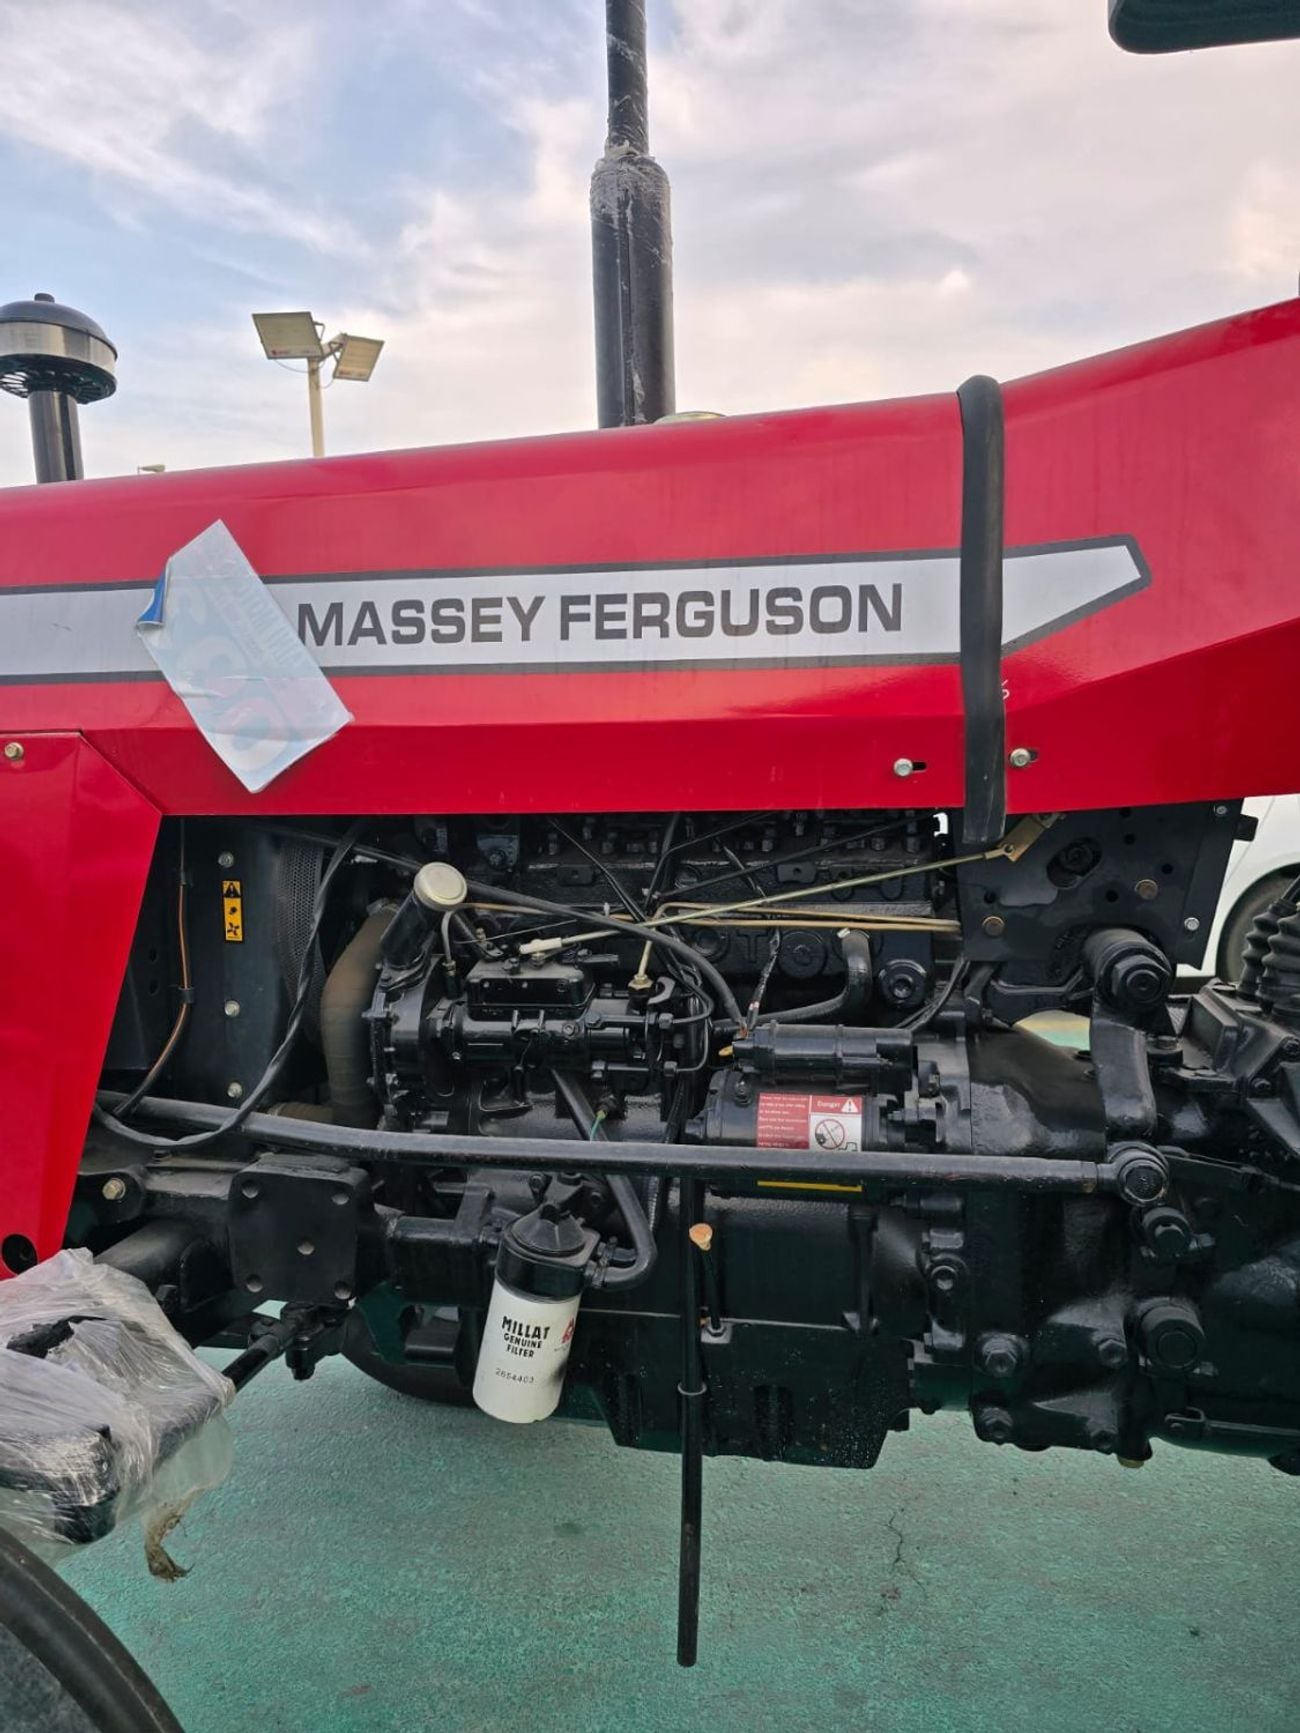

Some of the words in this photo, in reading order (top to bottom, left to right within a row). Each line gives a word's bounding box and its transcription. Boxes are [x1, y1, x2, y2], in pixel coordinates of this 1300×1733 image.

[298, 595, 545, 647] MASSEY
[560, 583, 902, 640] FERGUSON
[816, 1101, 841, 1110] Danger
[501, 1315, 550, 1340] MILLAT
[503, 1333, 542, 1349] GENUINE
[506, 1344, 535, 1358] FILTER
